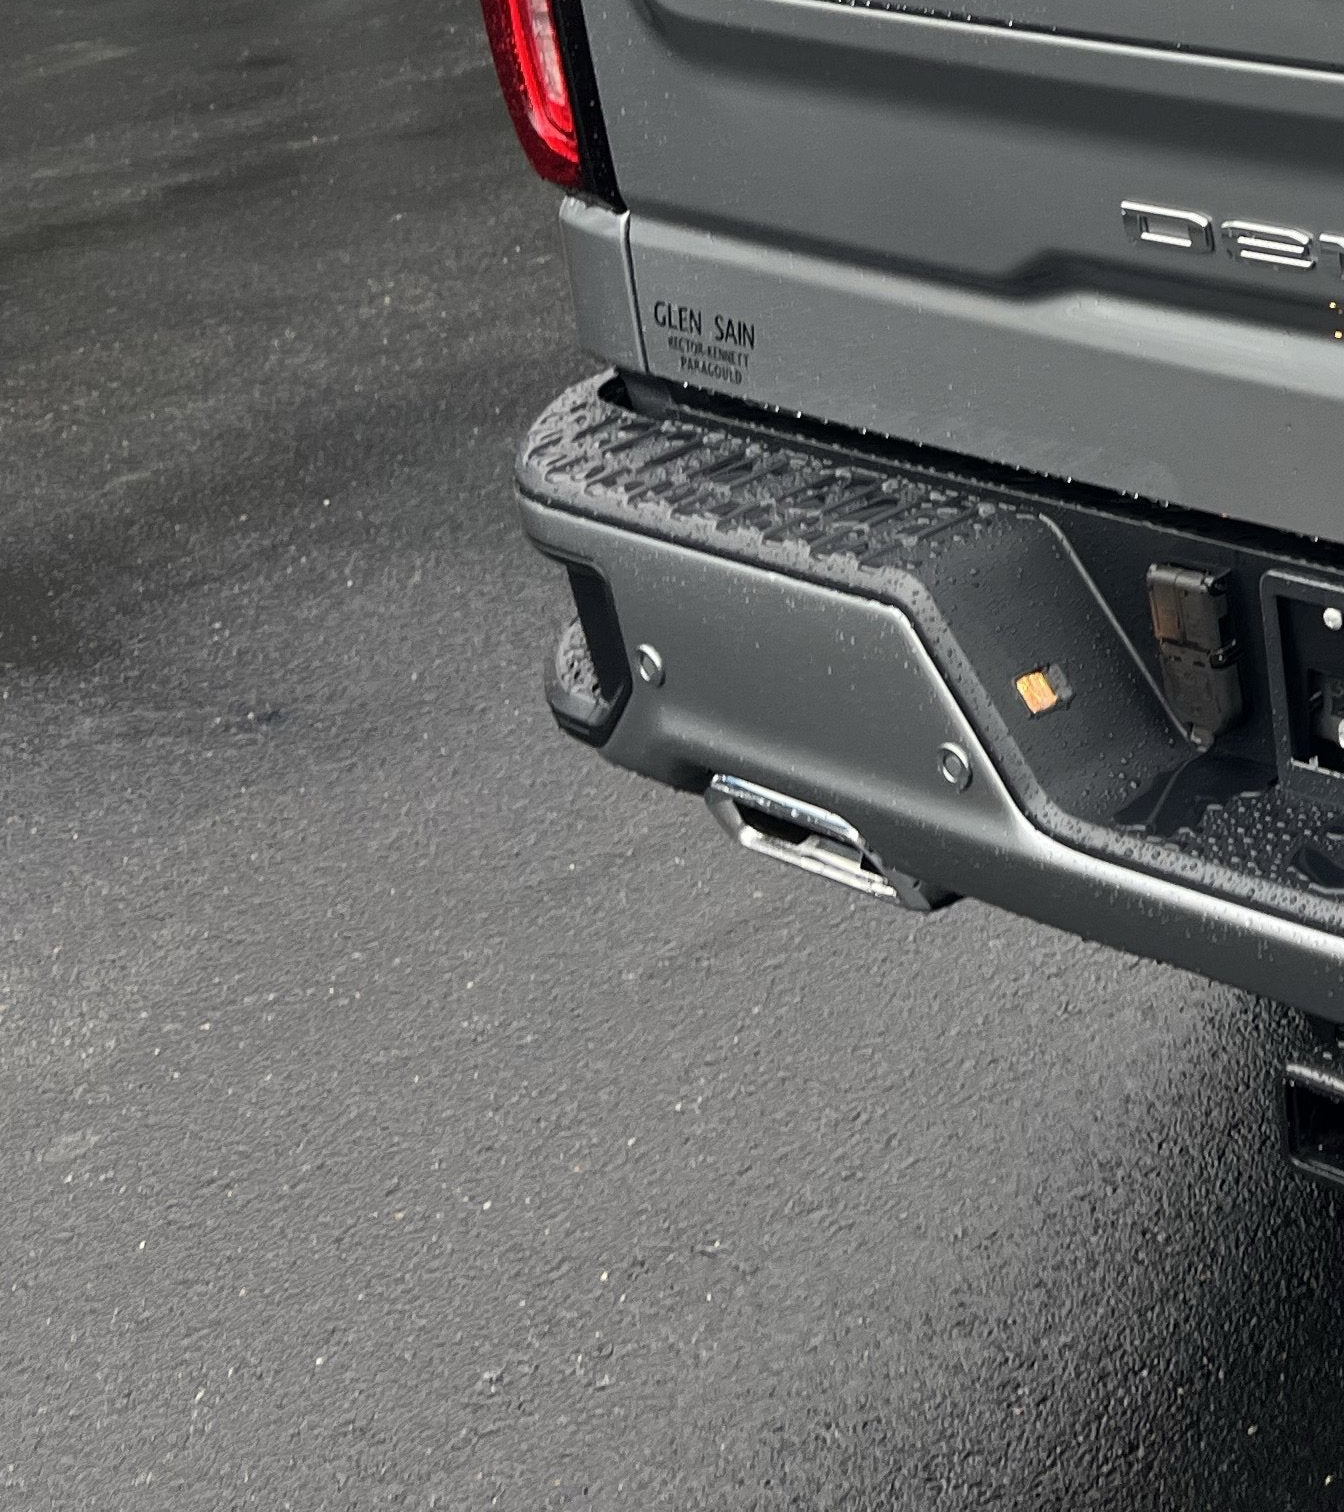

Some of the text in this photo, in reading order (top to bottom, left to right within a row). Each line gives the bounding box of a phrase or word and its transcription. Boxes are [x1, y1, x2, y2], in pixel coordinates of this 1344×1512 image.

[654, 300, 755, 350] GLEN SAIN
[680, 355, 743, 385] PARAGOULD
